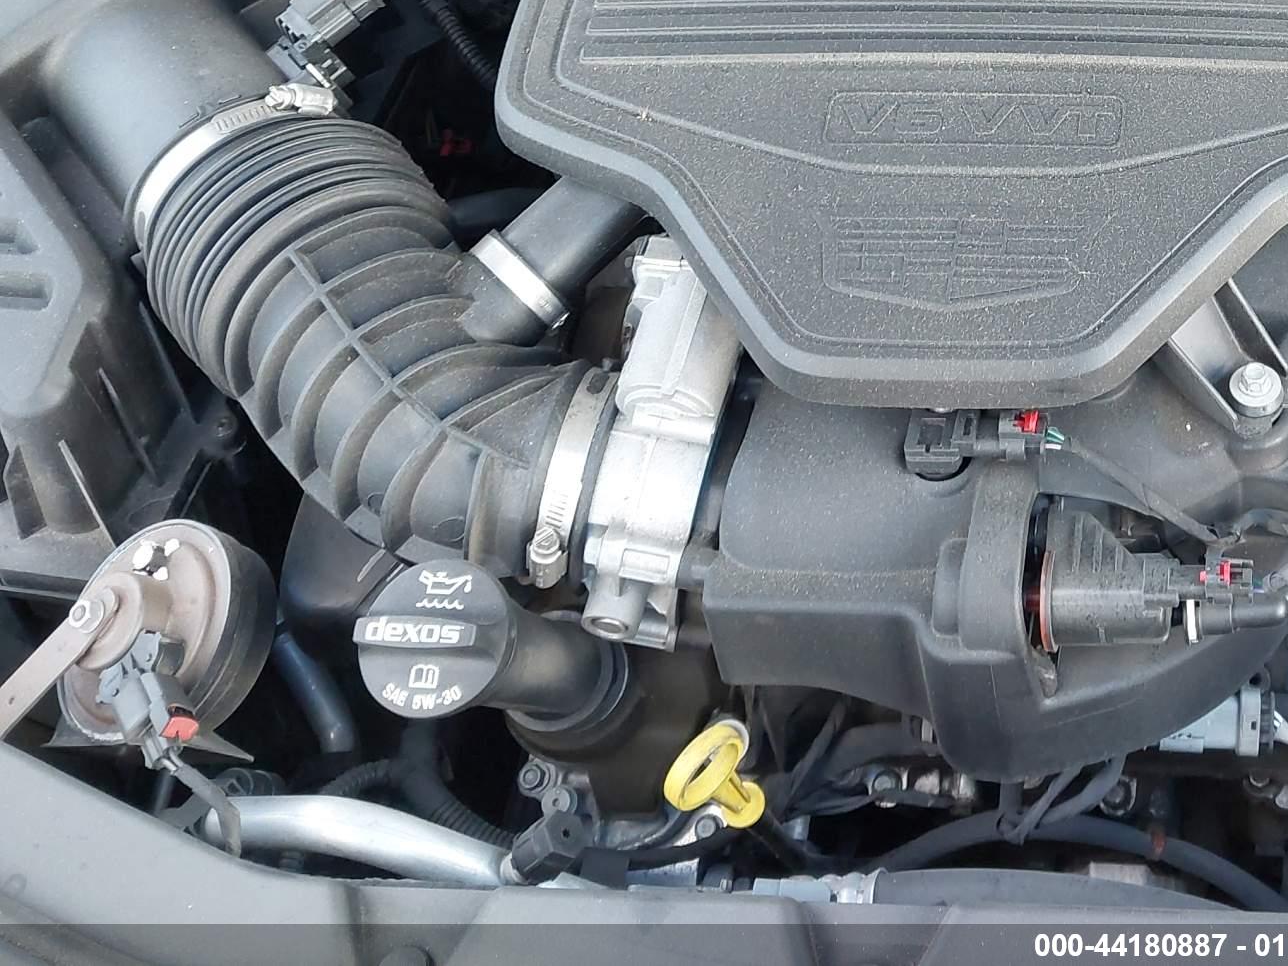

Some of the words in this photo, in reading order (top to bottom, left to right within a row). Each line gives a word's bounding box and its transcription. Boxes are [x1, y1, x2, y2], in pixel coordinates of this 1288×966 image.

[364, 615, 465, 644] dexos
[382, 683, 408, 707] SAE
[412, 685, 462, 710] 5W-30
